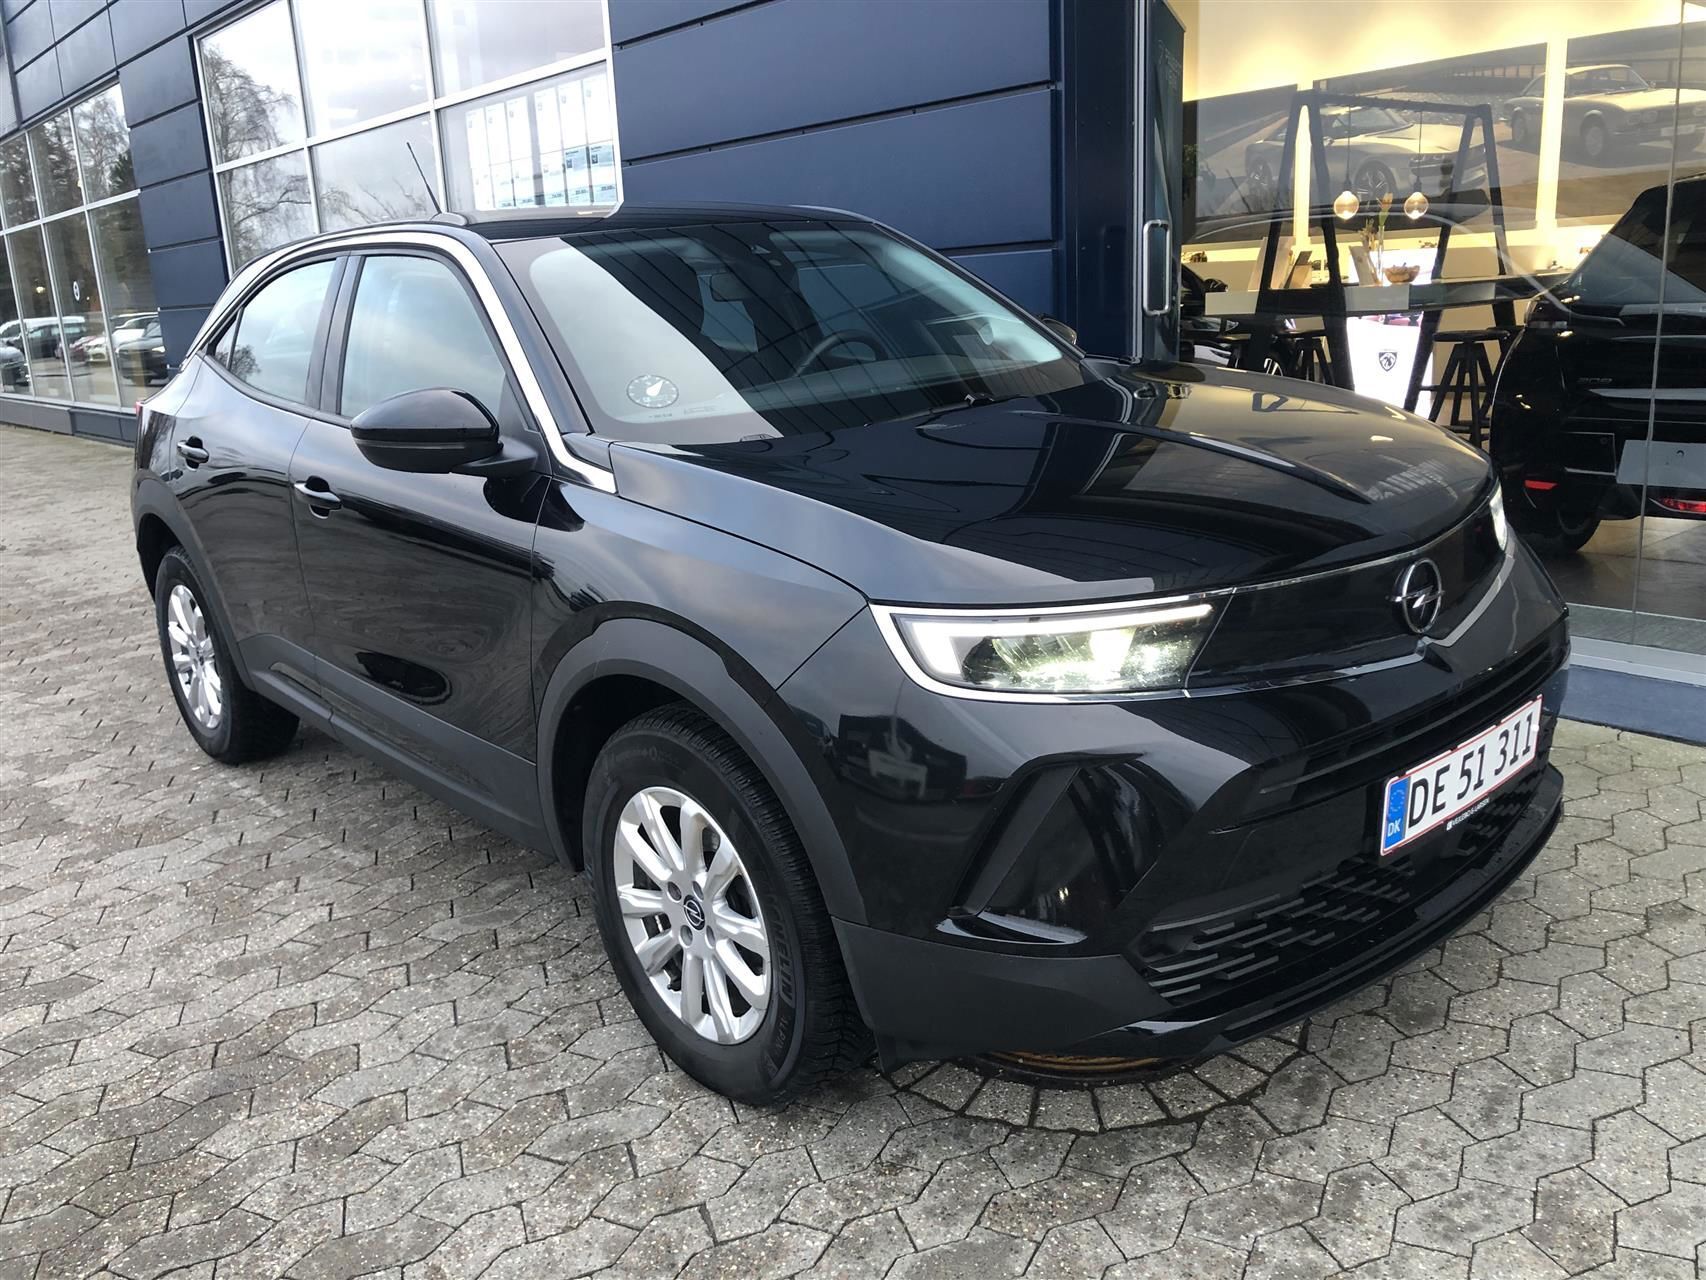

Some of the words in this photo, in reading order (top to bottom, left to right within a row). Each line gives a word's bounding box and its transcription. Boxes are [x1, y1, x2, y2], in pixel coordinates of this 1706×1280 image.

[1408, 764, 1450, 828] DE
[1457, 744, 1485, 800] 51
[1494, 712, 1533, 776] 311
[1388, 818, 1401, 837] DK
